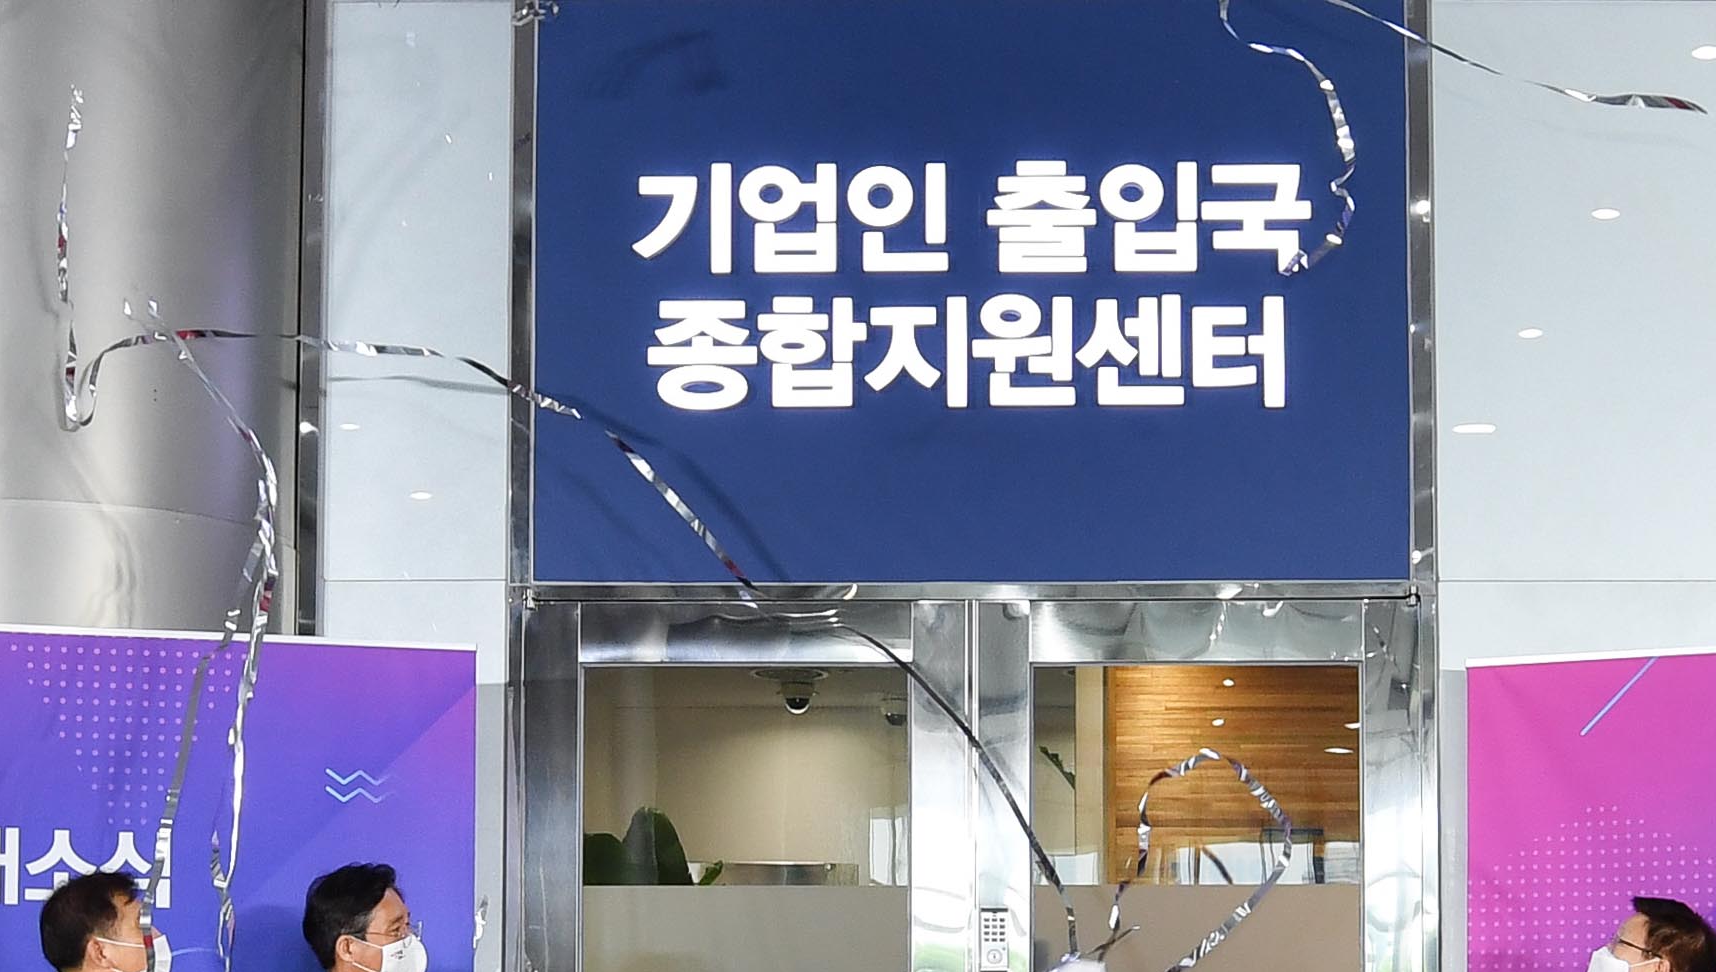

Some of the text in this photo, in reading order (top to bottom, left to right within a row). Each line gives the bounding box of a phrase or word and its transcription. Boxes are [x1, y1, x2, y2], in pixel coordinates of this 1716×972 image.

[631, 160, 1312, 275] 기업인 출입국
[646, 293, 1287, 410] 종합지원센터
